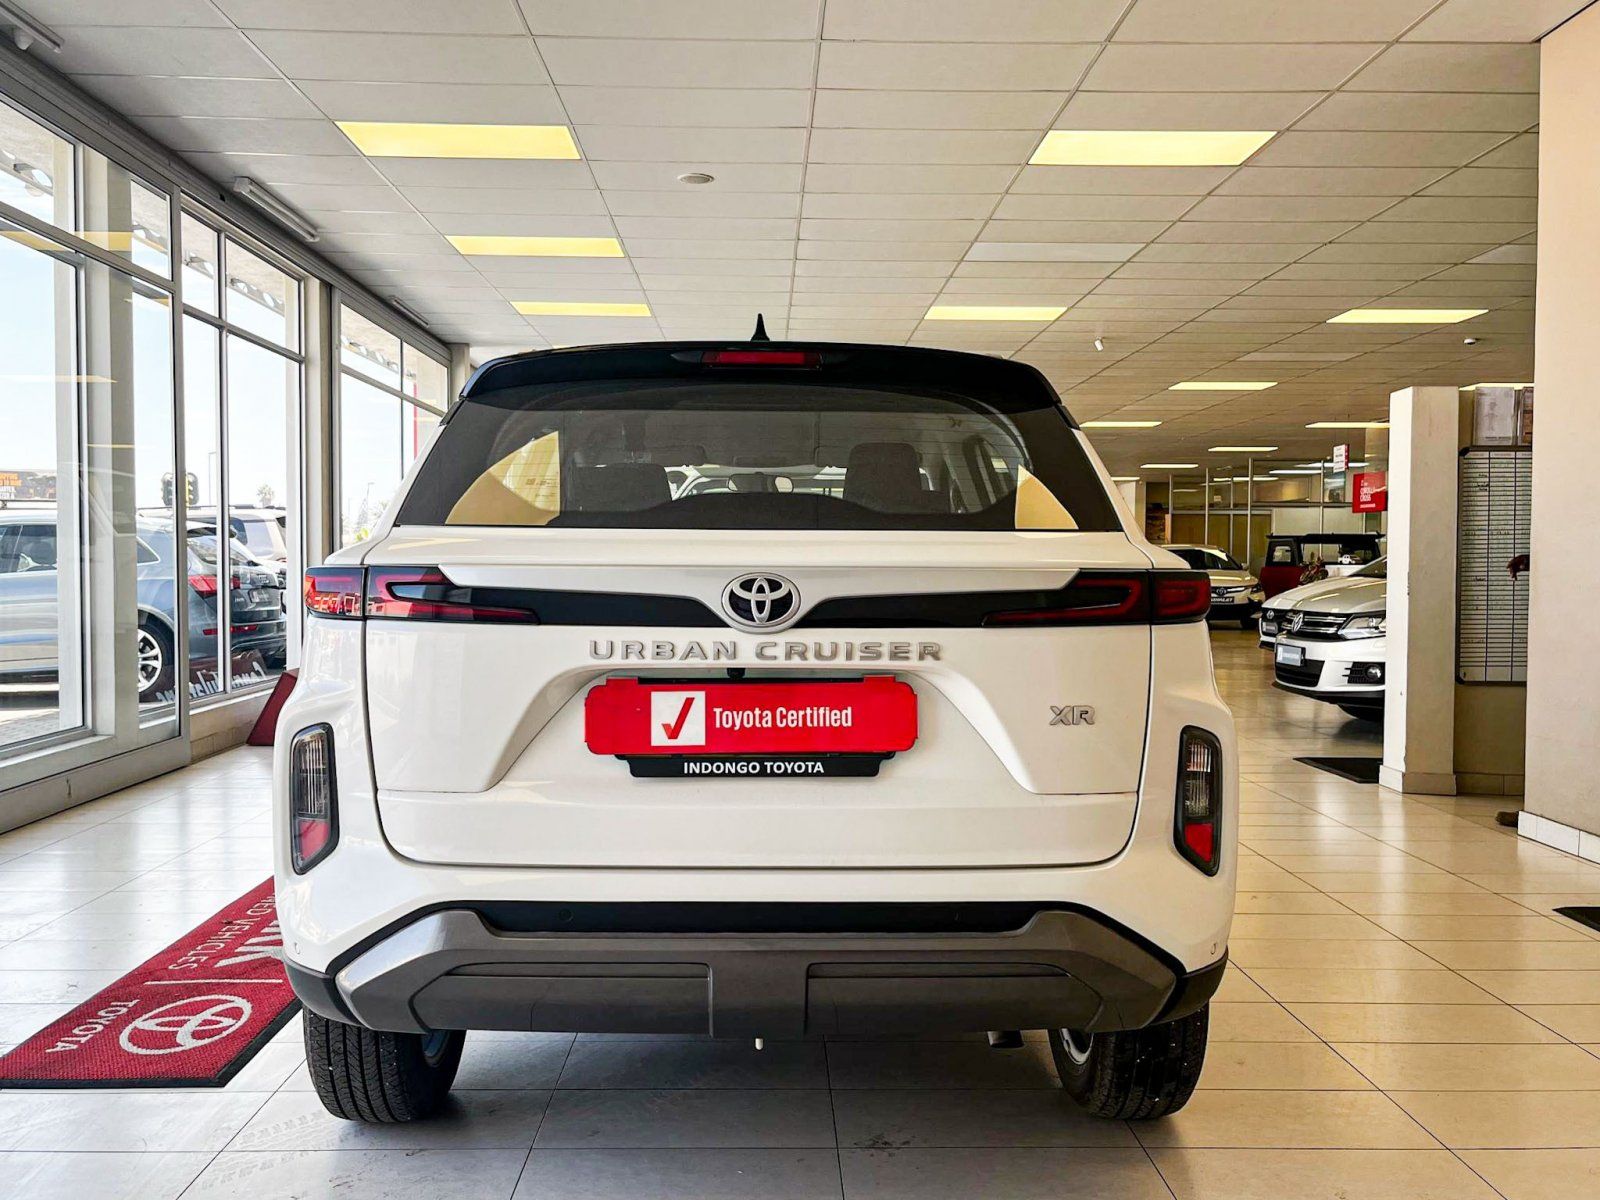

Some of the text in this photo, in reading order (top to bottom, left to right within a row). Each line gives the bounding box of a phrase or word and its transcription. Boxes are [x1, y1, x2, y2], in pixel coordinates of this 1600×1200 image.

[589, 640, 942, 661] URBAN CRUISER
[713, 706, 852, 730] Toyota Certified
[1049, 705, 1096, 725] XR
[683, 761, 825, 774] INDONGO TOYOTA
[168, 917, 261, 970] VEHICLES
[45, 999, 140, 1051] TOYOTA
